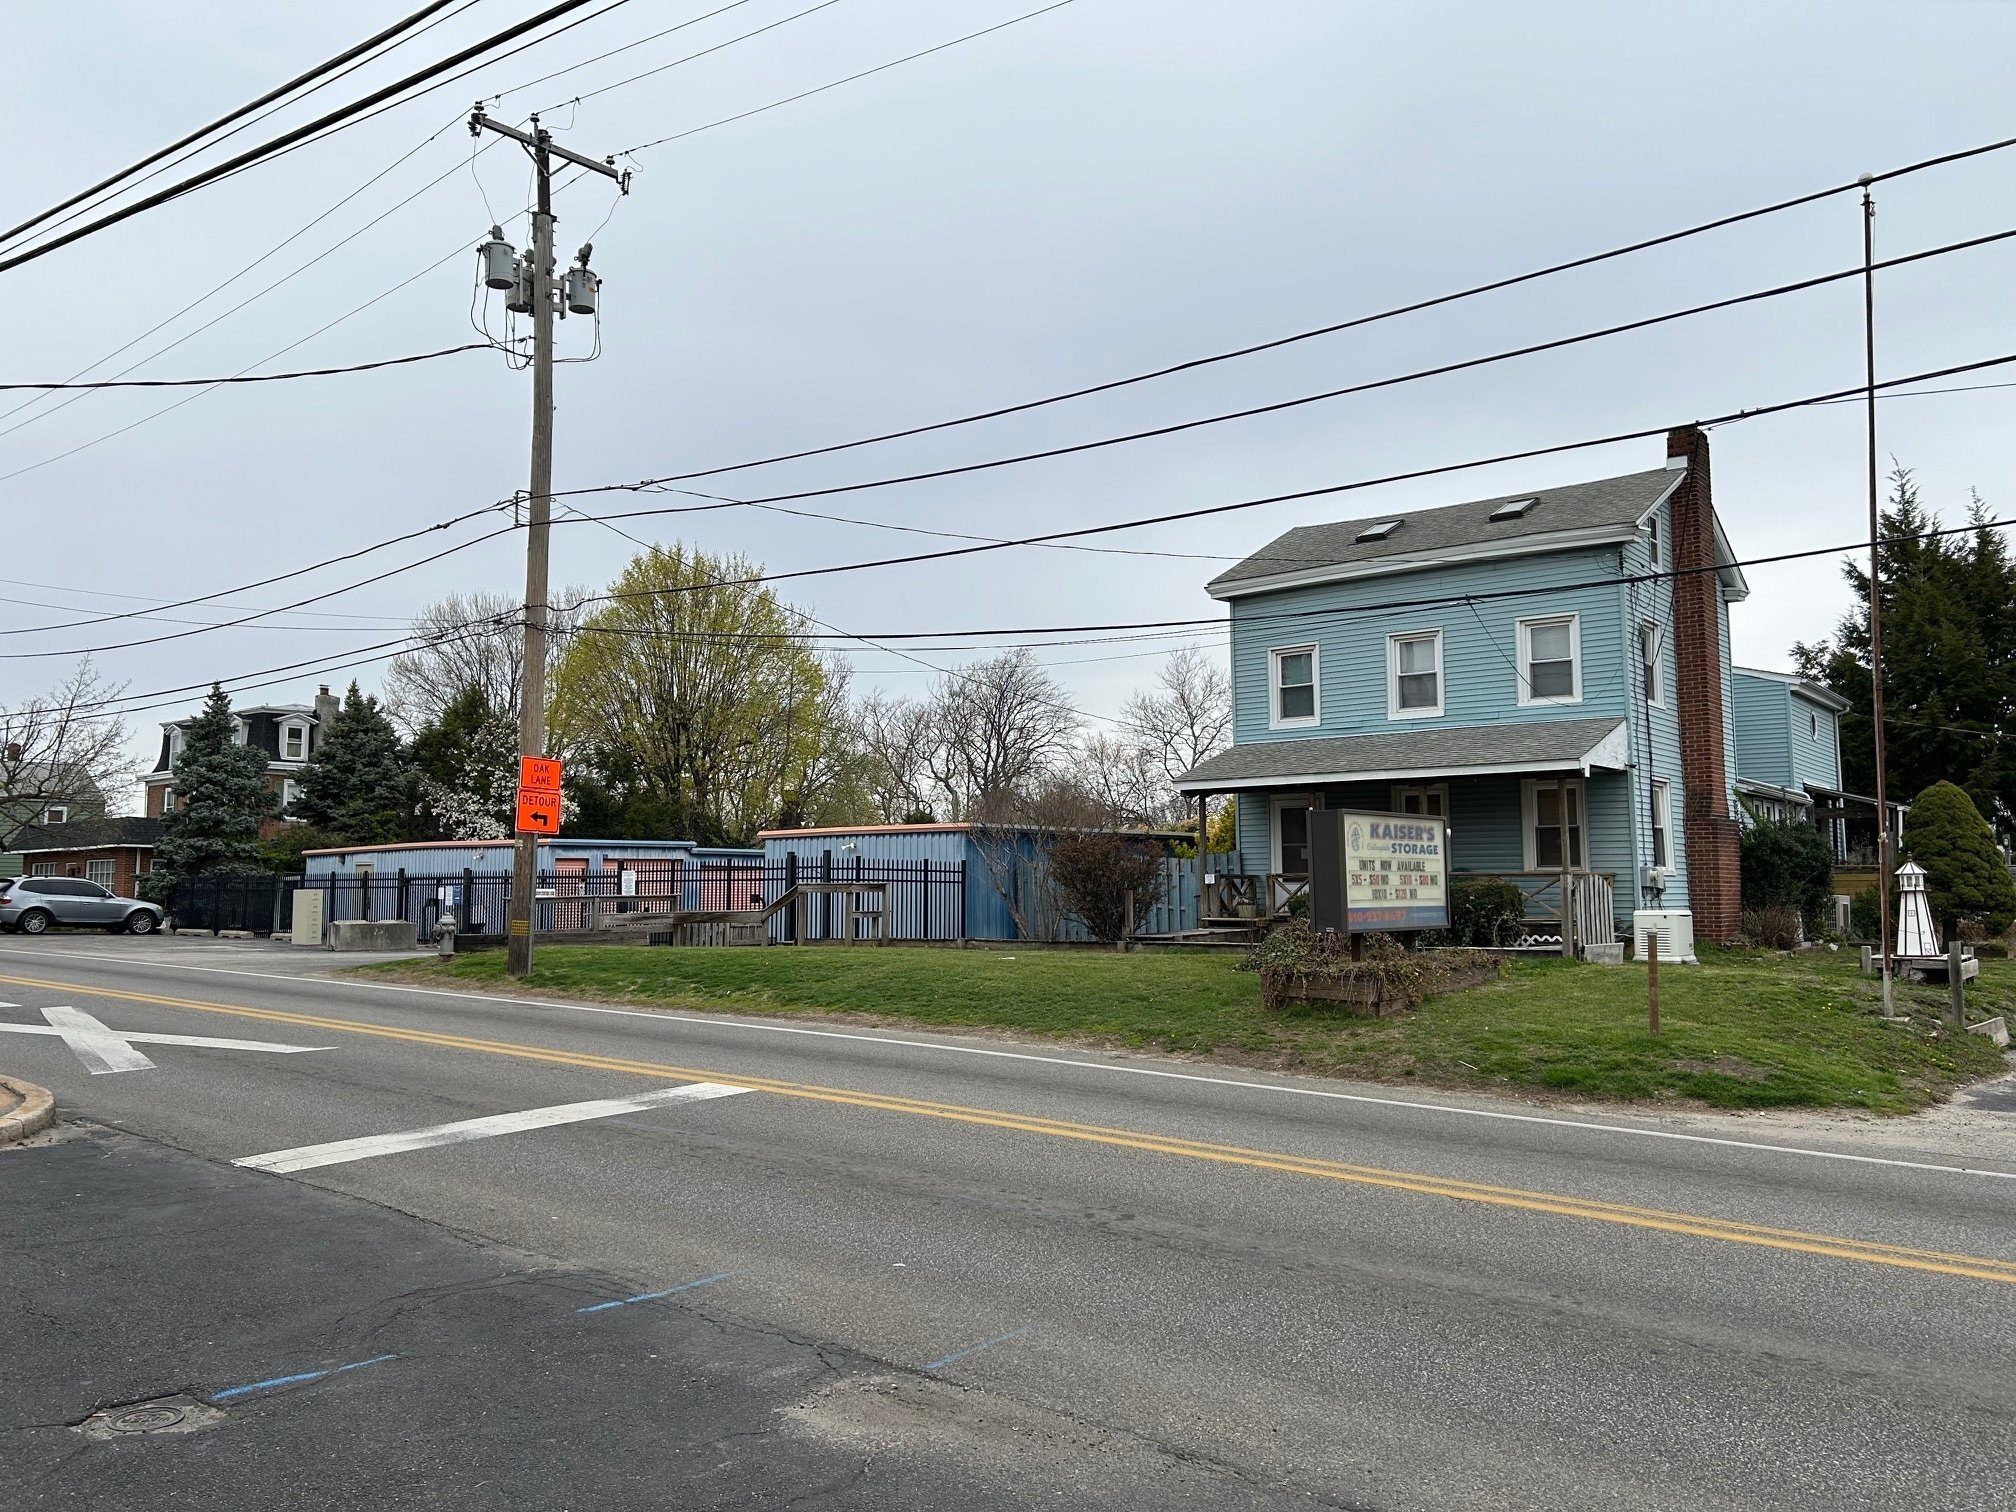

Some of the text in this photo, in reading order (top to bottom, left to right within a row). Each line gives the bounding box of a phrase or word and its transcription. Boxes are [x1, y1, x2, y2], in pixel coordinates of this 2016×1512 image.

[533, 763, 550, 774] OAK
[530, 774, 552, 786] LANE
[522, 794, 557, 808] DETOUR
[1370, 823, 1435, 842] KAISER'S
[1391, 842, 1439, 855] STORAGE
[1359, 859, 1426, 872] UNITS NOW AVAILABLE
